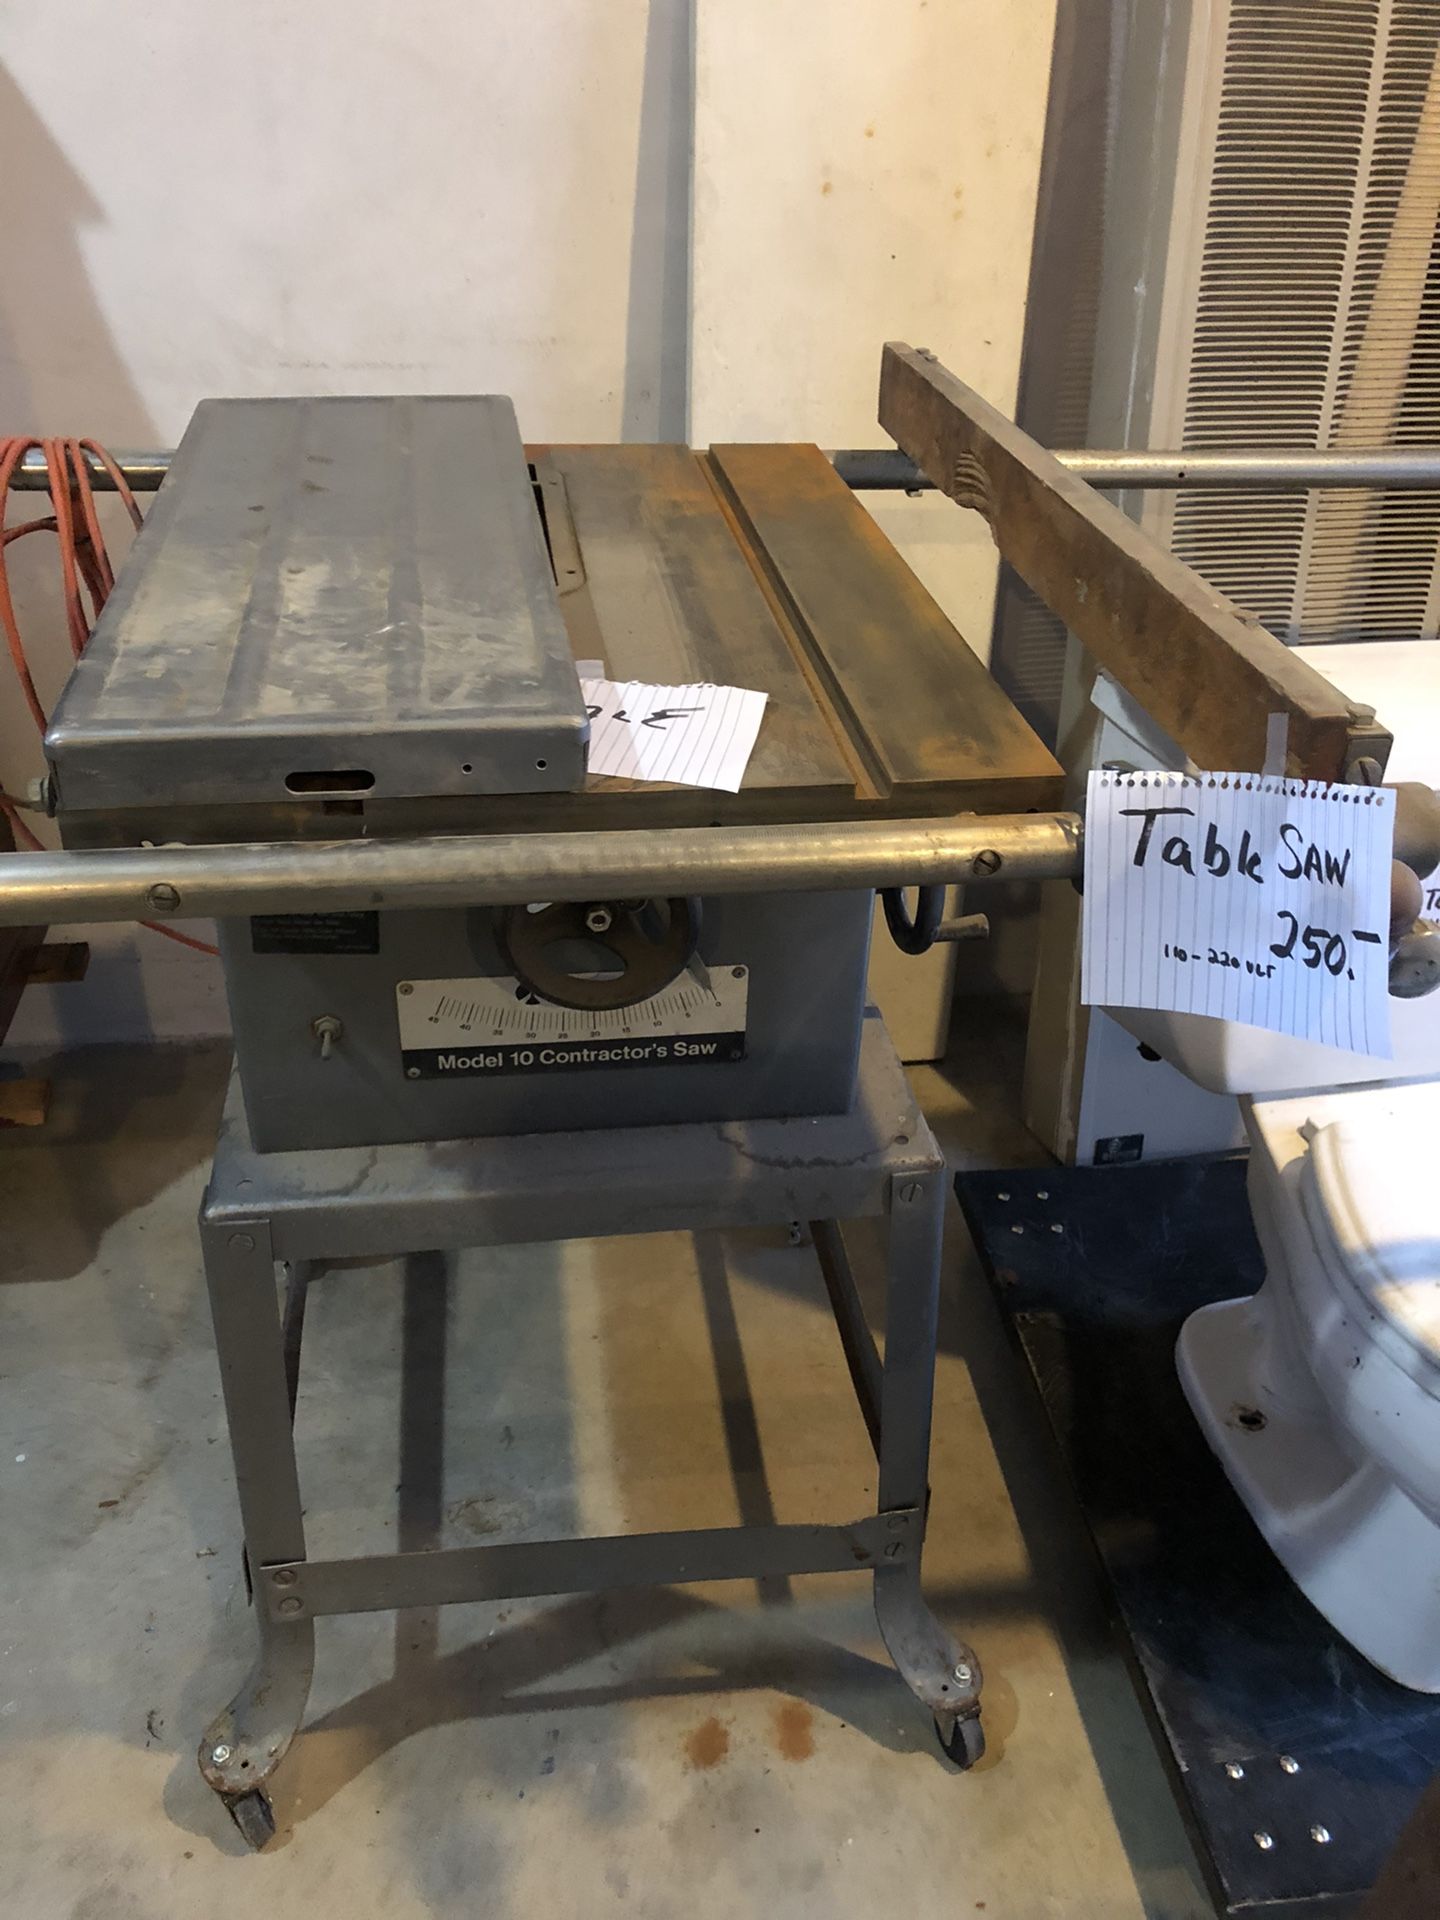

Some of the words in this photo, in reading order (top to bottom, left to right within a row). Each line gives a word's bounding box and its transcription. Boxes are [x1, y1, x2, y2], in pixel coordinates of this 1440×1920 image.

[1119, 807, 1264, 884] Table
[1278, 823, 1351, 887] SAW
[438, 1052, 503, 1070] Model
[510, 1050, 535, 1066] 10
[539, 1043, 668, 1065] Contractor's
[673, 1041, 718, 1057] Saw
